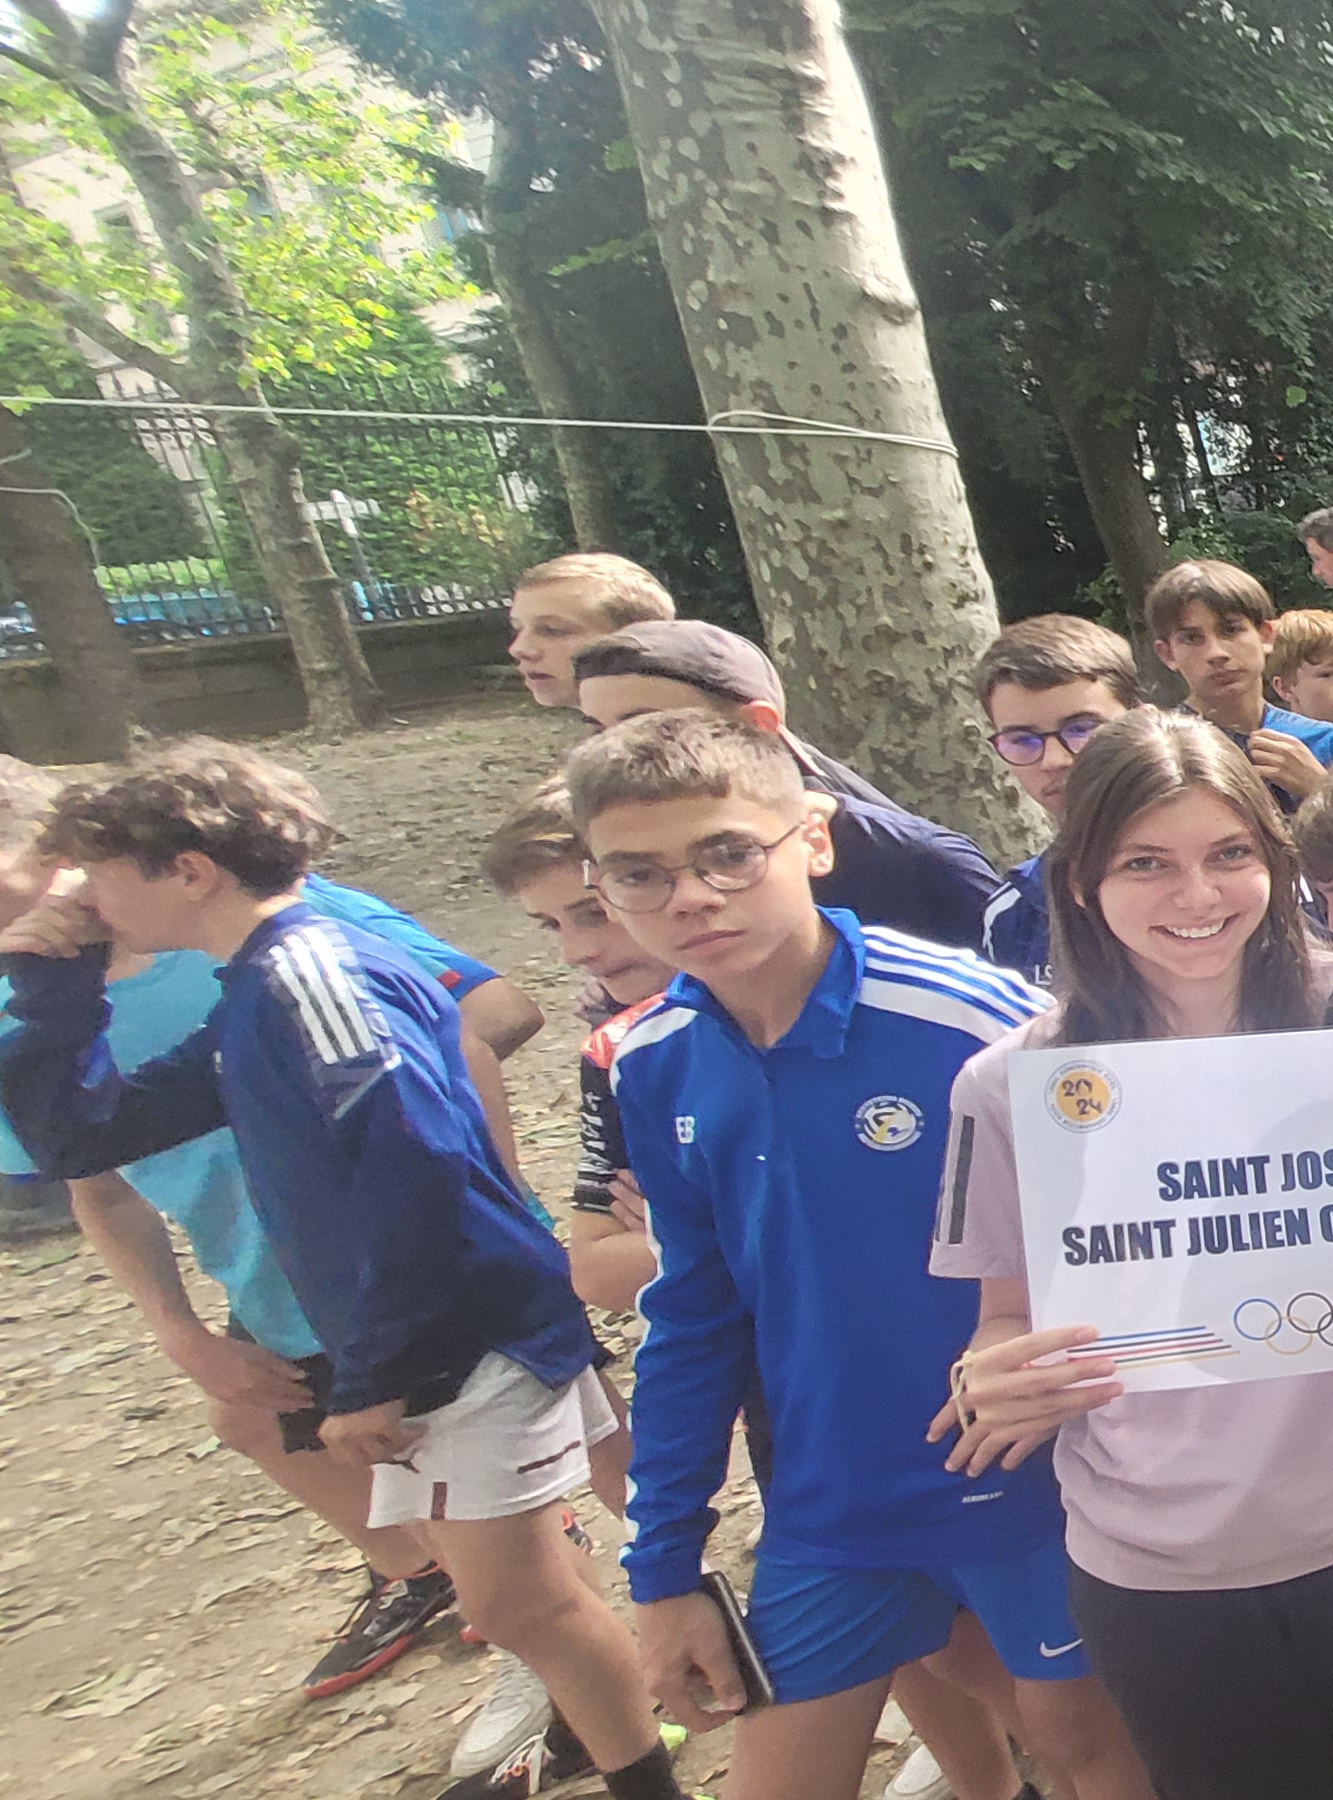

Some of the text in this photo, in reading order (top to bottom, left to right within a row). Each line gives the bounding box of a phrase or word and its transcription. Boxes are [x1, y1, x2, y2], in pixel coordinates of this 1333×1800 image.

[1061, 1078, 1093, 1098] 20
[1076, 1097, 1103, 1116] 24
[1157, 1154, 1270, 1202] SAINT
[1062, 1218, 1176, 1266] SAINT
[1187, 1207, 1312, 1256] JULIEN
